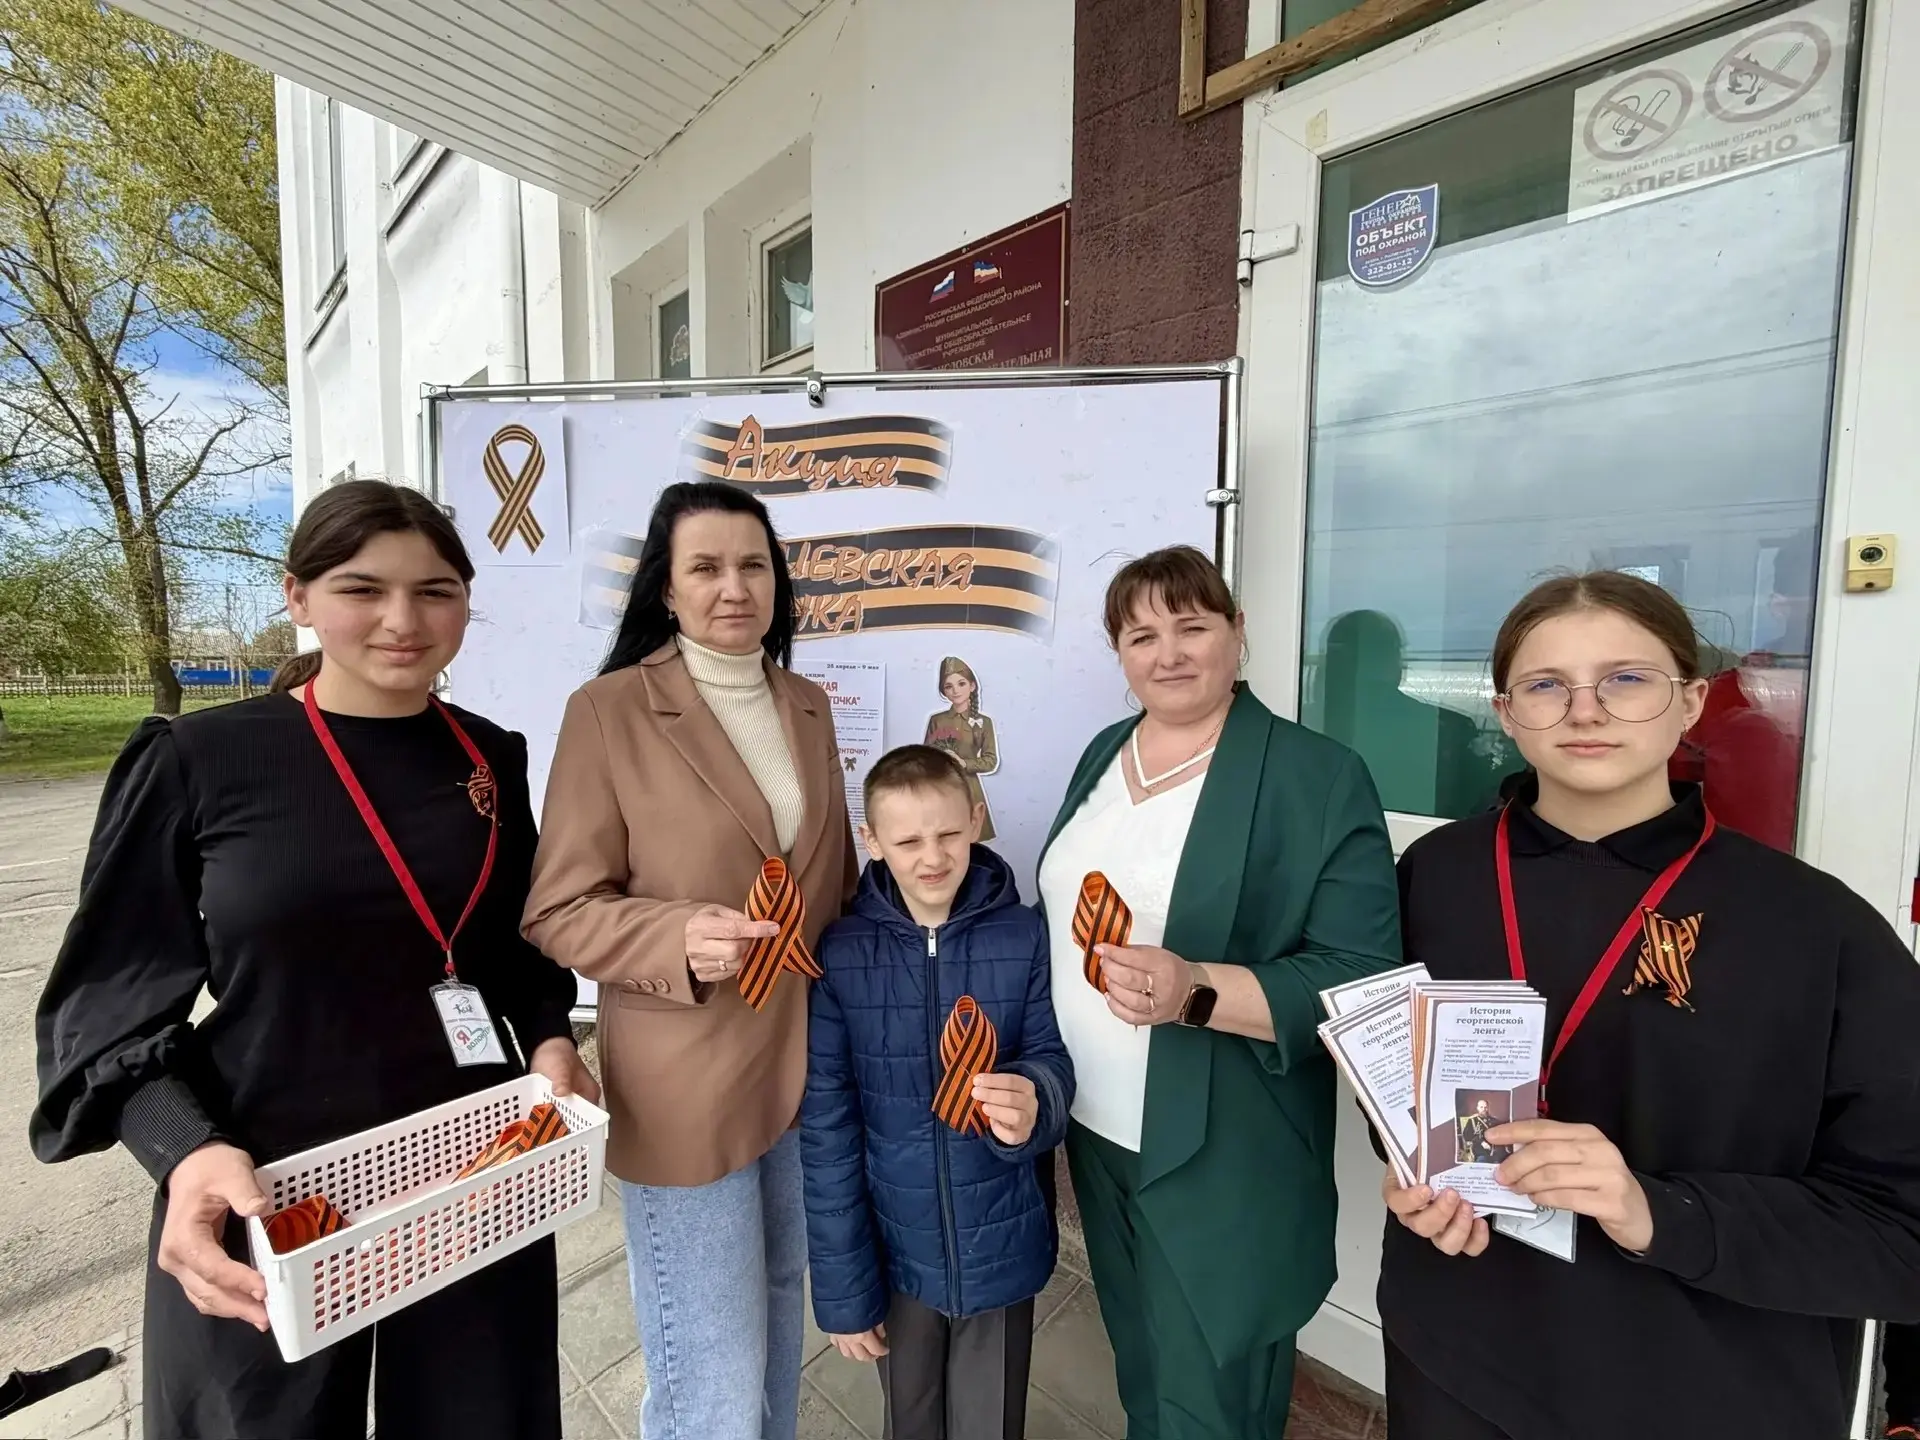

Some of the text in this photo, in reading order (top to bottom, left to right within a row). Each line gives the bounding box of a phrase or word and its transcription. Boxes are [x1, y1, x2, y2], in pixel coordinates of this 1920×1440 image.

[1598, 133, 1799, 203] ЗАПРЕЩЕНО
[1356, 215, 1427, 247] ОБЪЕКТ
[1355, 228, 1427, 258] ПОД ОХРАНОЙ
[1367, 257, 1412, 276] 322-01-12
[966, 286, 1005, 307] ФЕДЕРАЦИЯ
[1013, 282, 1042, 299] РАЙОНА
[722, 413, 899, 492] Акция
[1363, 981, 1401, 998] История
[1469, 1006, 1511, 1017] История
[1366, 1011, 1403, 1034] История
[1456, 1016, 1524, 1027] георгиевской
[1472, 1027, 1506, 1035] ленты
[456, 1030, 470, 1045] Я
[1362, 1018, 1412, 1048] георгиевско
[1382, 1032, 1410, 1050] ленты
